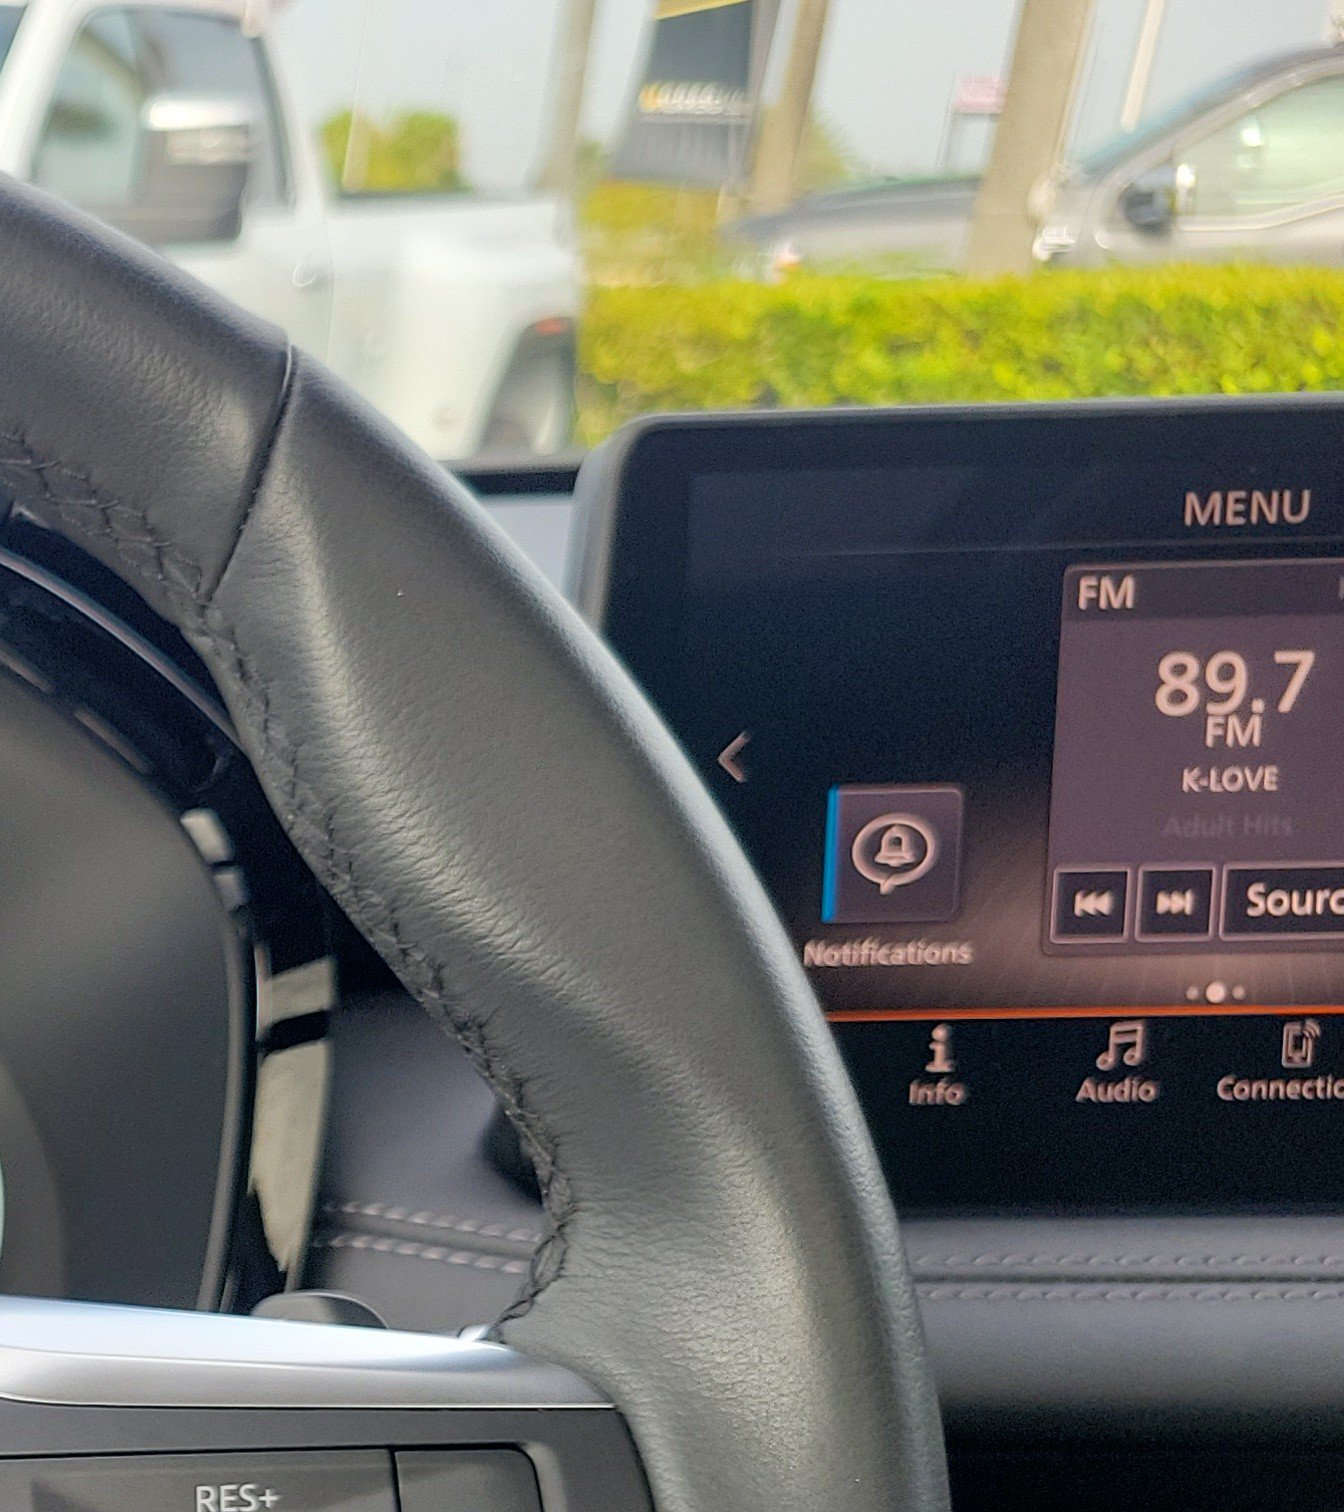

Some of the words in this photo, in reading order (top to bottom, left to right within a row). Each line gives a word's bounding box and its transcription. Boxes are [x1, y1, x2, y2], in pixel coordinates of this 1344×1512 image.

[1183, 488, 1311, 527] MENU
[1078, 575, 1134, 610] FM
[1155, 650, 1316, 717] 89.7
[1205, 713, 1263, 748] FM
[1181, 765, 1280, 793] K-LOVE
[803, 939, 972, 968] Notifications
[908, 1080, 967, 1107] Info
[1075, 1075, 1158, 1103] Audio
